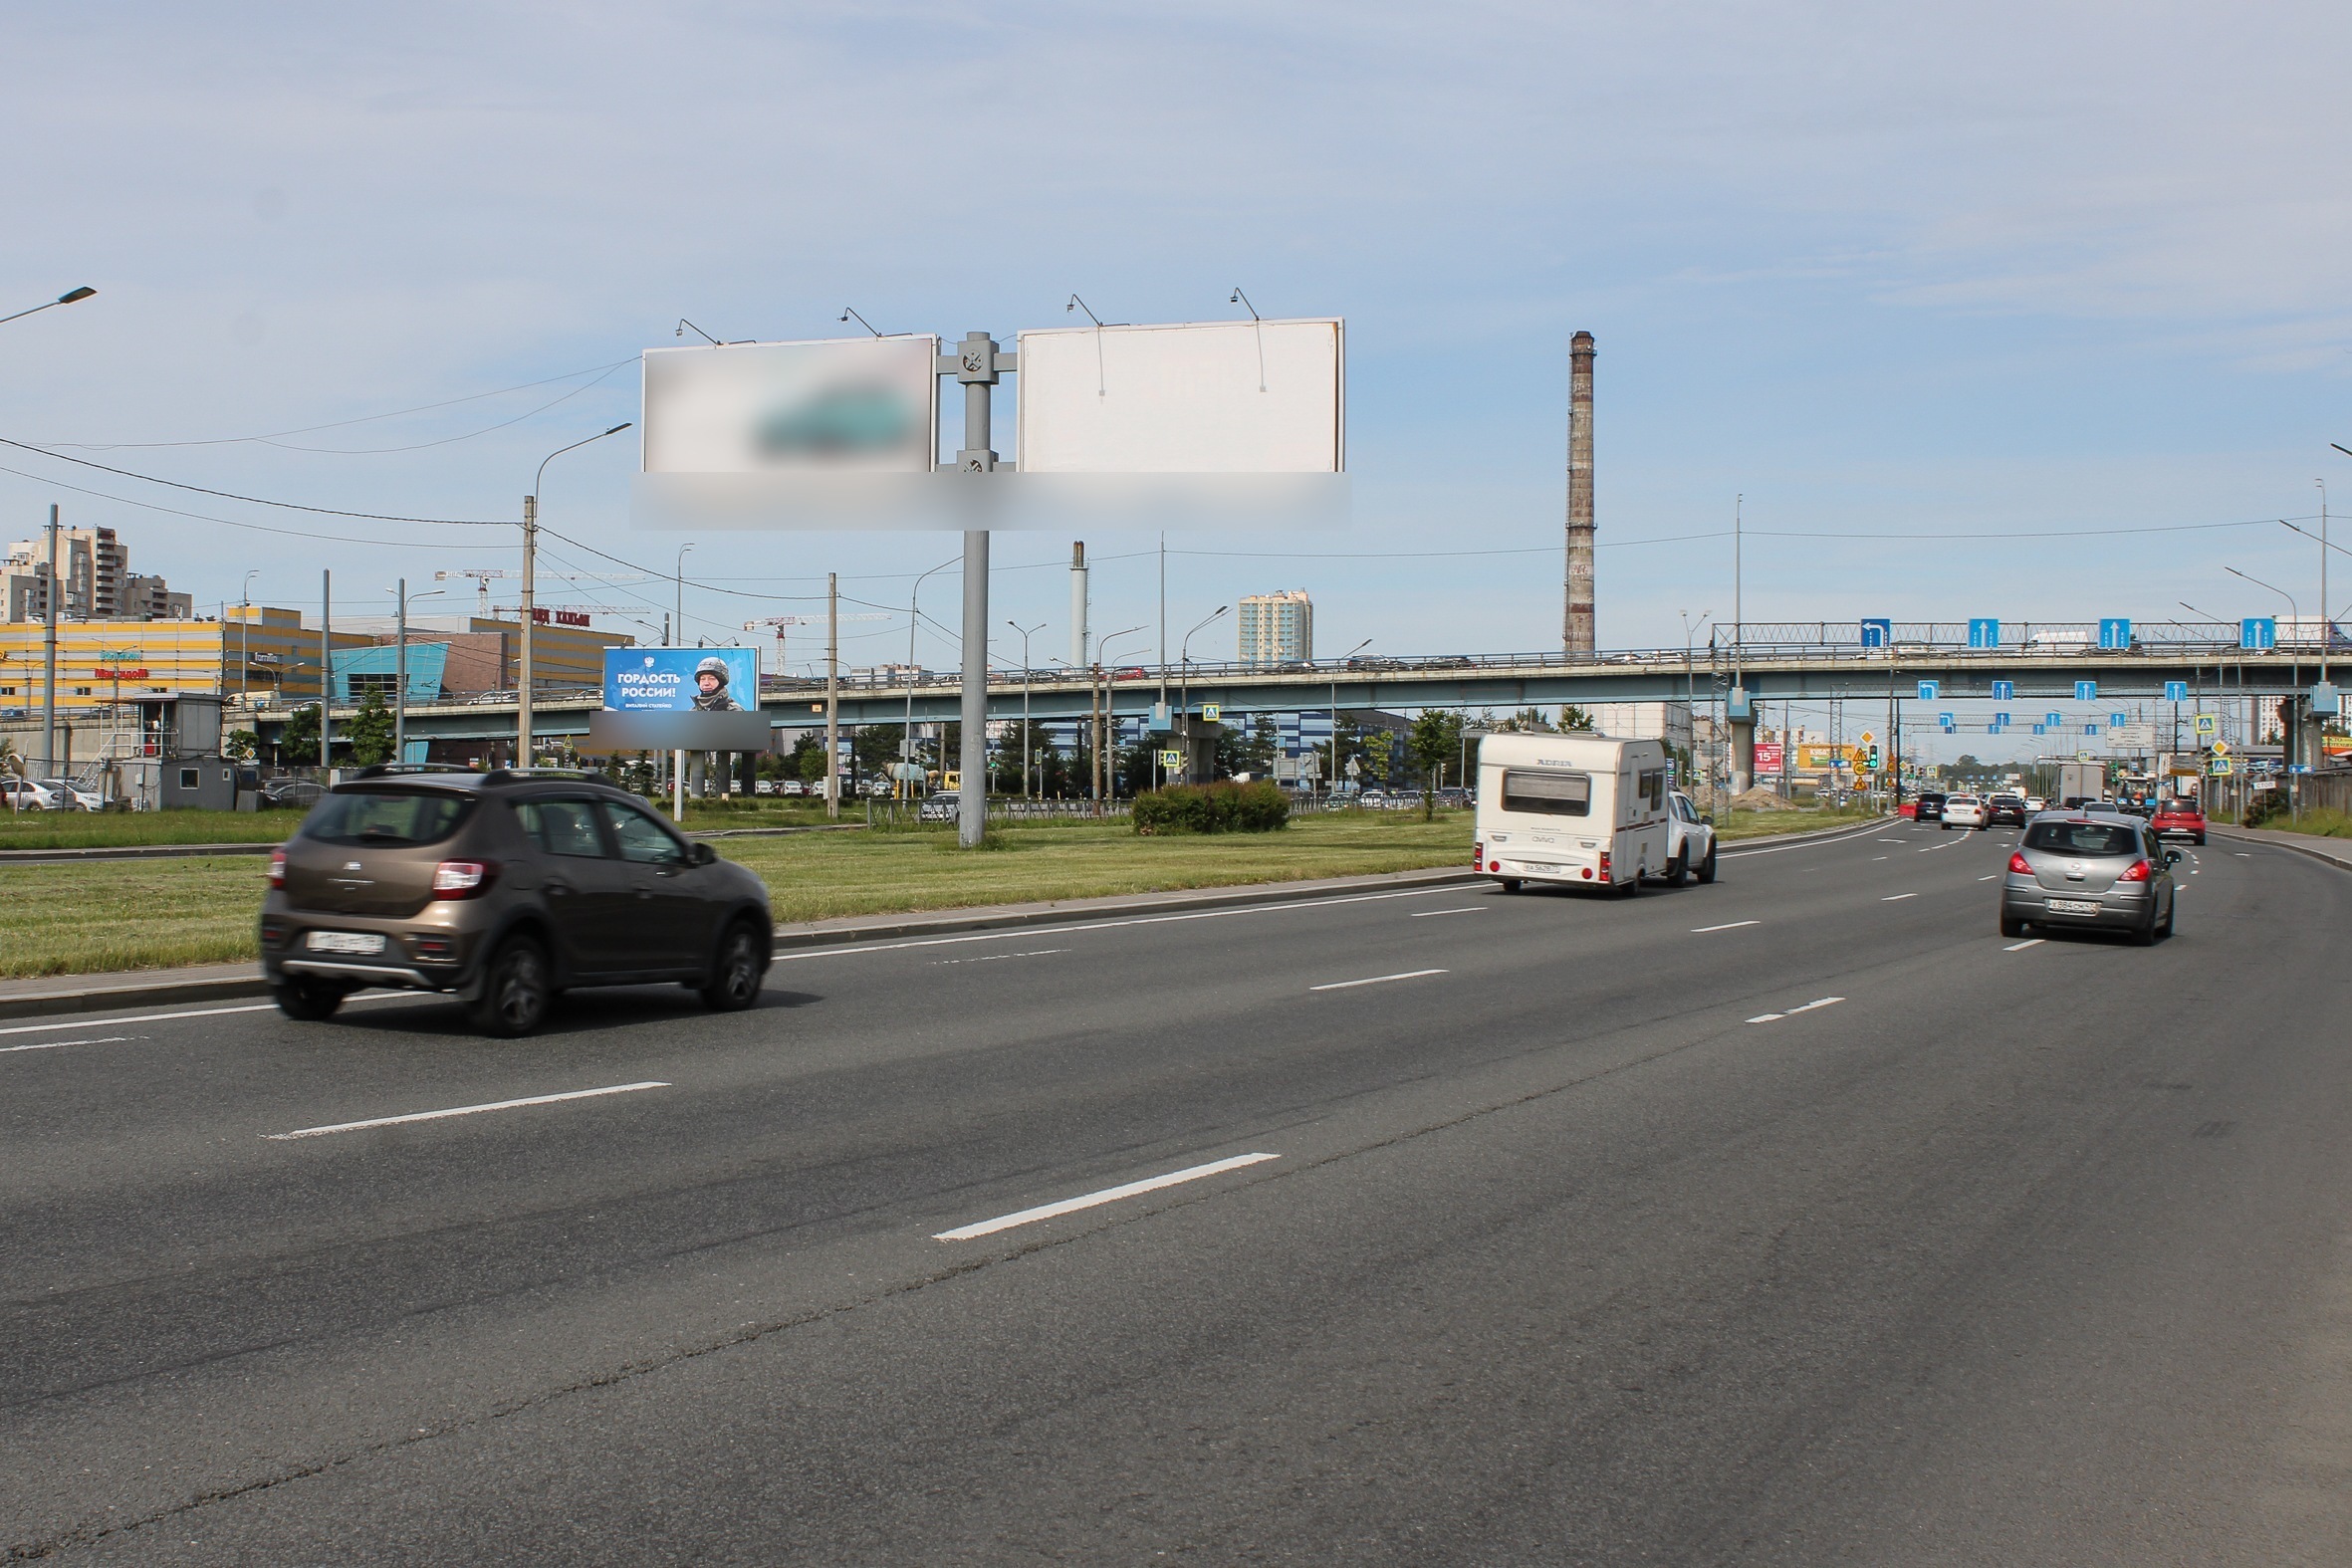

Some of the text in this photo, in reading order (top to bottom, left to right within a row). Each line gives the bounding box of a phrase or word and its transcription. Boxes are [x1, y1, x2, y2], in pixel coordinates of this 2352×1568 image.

[617, 673, 681, 685] ГОРДОСТЬ
[621, 688, 676, 698] РОССИИ!
[1757, 752, 1771, 762] 15
[1536, 759, 1572, 768] ADRIA
